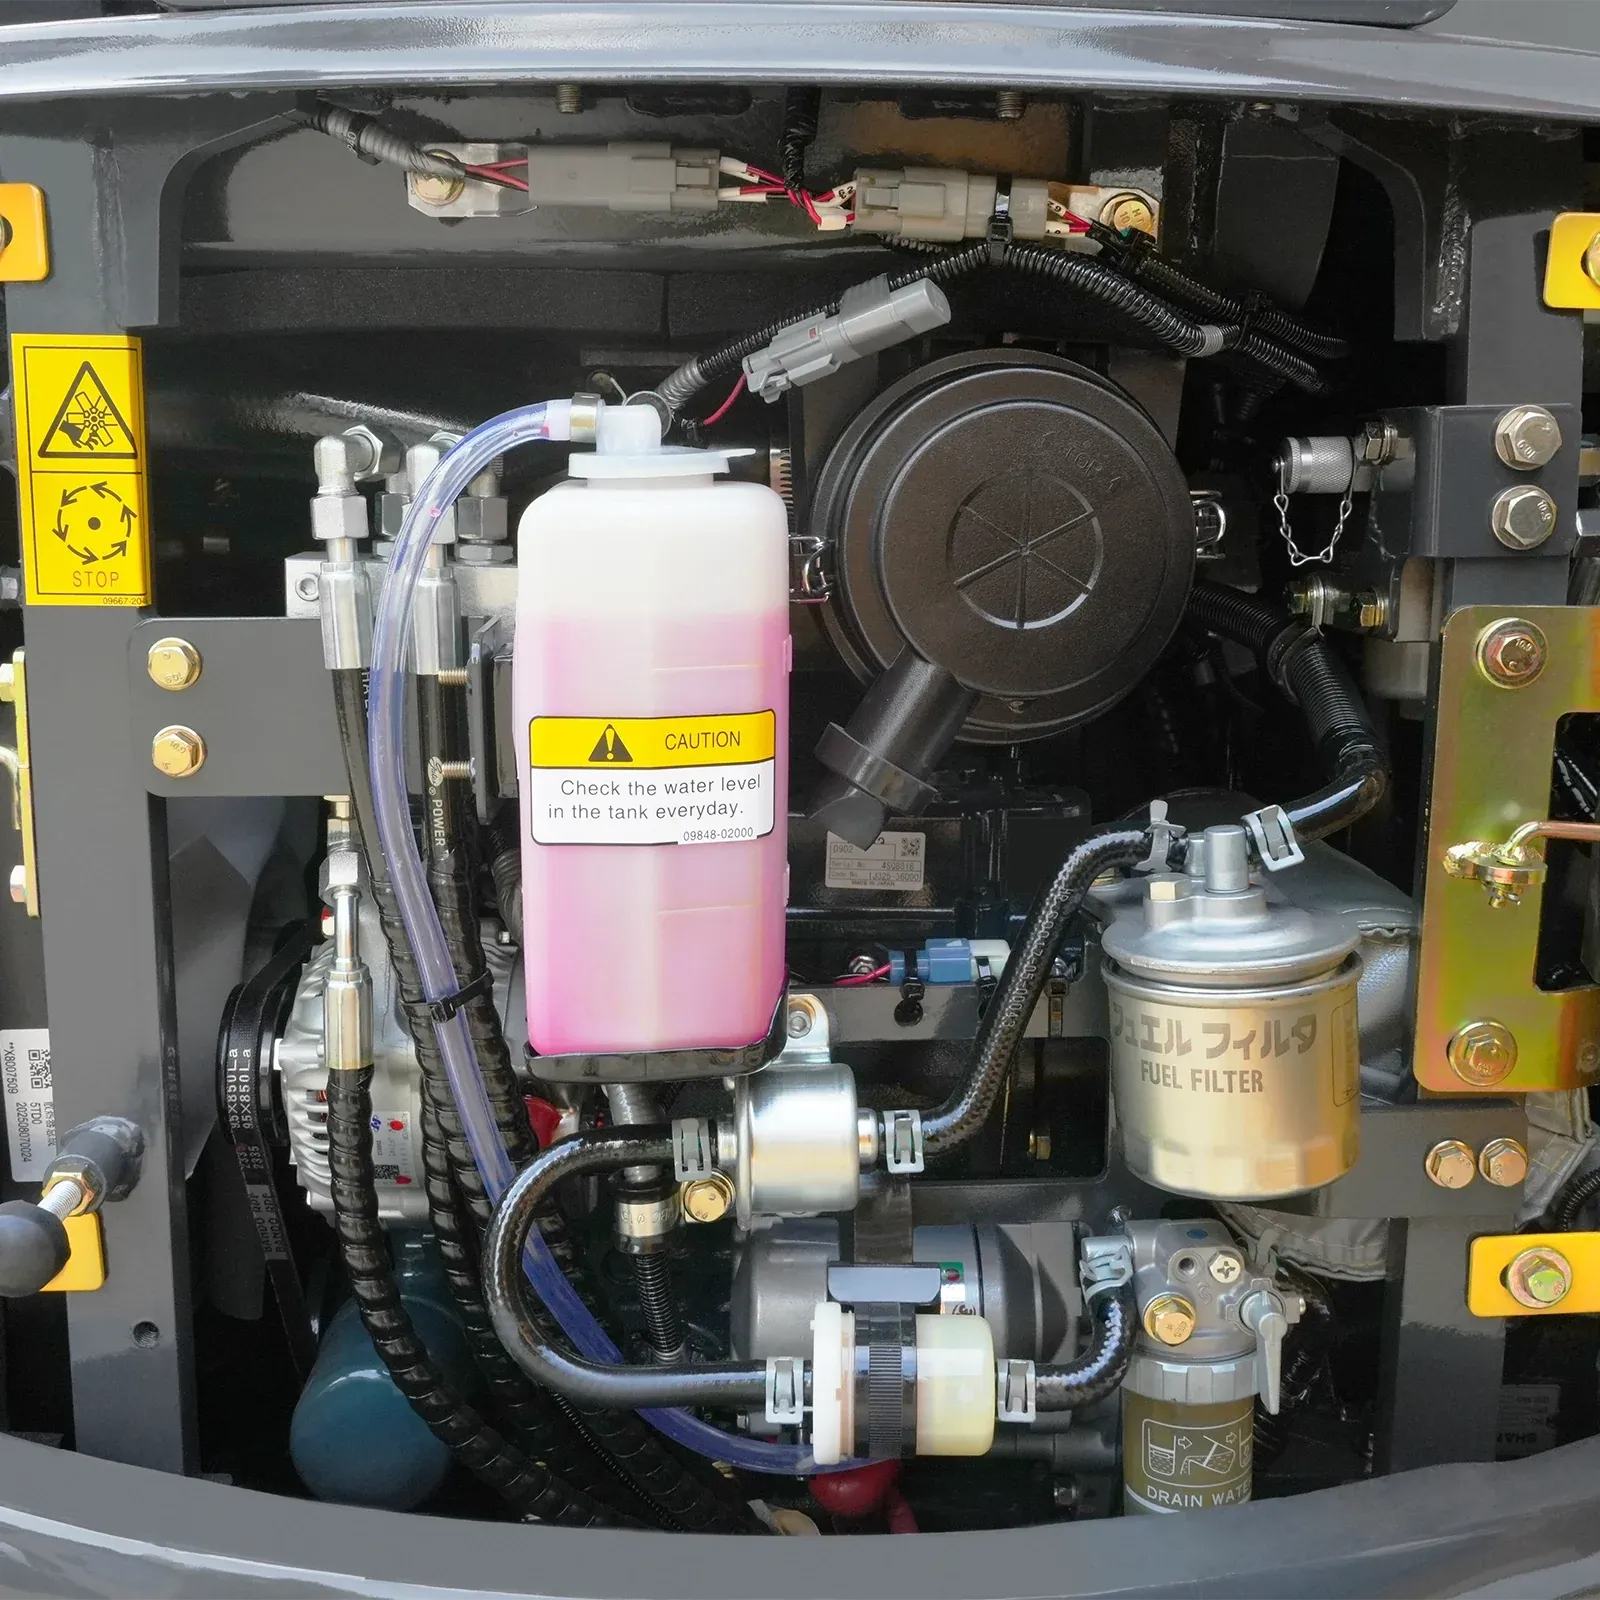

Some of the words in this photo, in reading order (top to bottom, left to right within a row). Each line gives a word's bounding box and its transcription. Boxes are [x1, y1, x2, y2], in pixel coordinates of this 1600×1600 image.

[72, 570, 119, 588] STOP
[664, 730, 741, 750] CAUTION
[560, 779, 621, 796] Check
[628, 780, 657, 796] the
[664, 778, 714, 795] water
[721, 774, 761, 792] level
[432, 799, 446, 846] POWER
[548, 804, 564, 819] in
[572, 804, 601, 819] the
[608, 804, 648, 819] tank
[655, 800, 744, 820] everyday.
[683, 827, 754, 842] 09848-02000
[1112, 1001, 1192, 1057] フュエル
[1202, 1013, 1317, 1061] フィルタ
[1141, 1058, 1183, 1090] FUEL
[1190, 1068, 1264, 1094] FILTER
[16, 1102, 32, 1163] 202508070024
[1147, 1485, 1203, 1508] DRAIN
[1212, 1477, 1252, 1506] WATE
